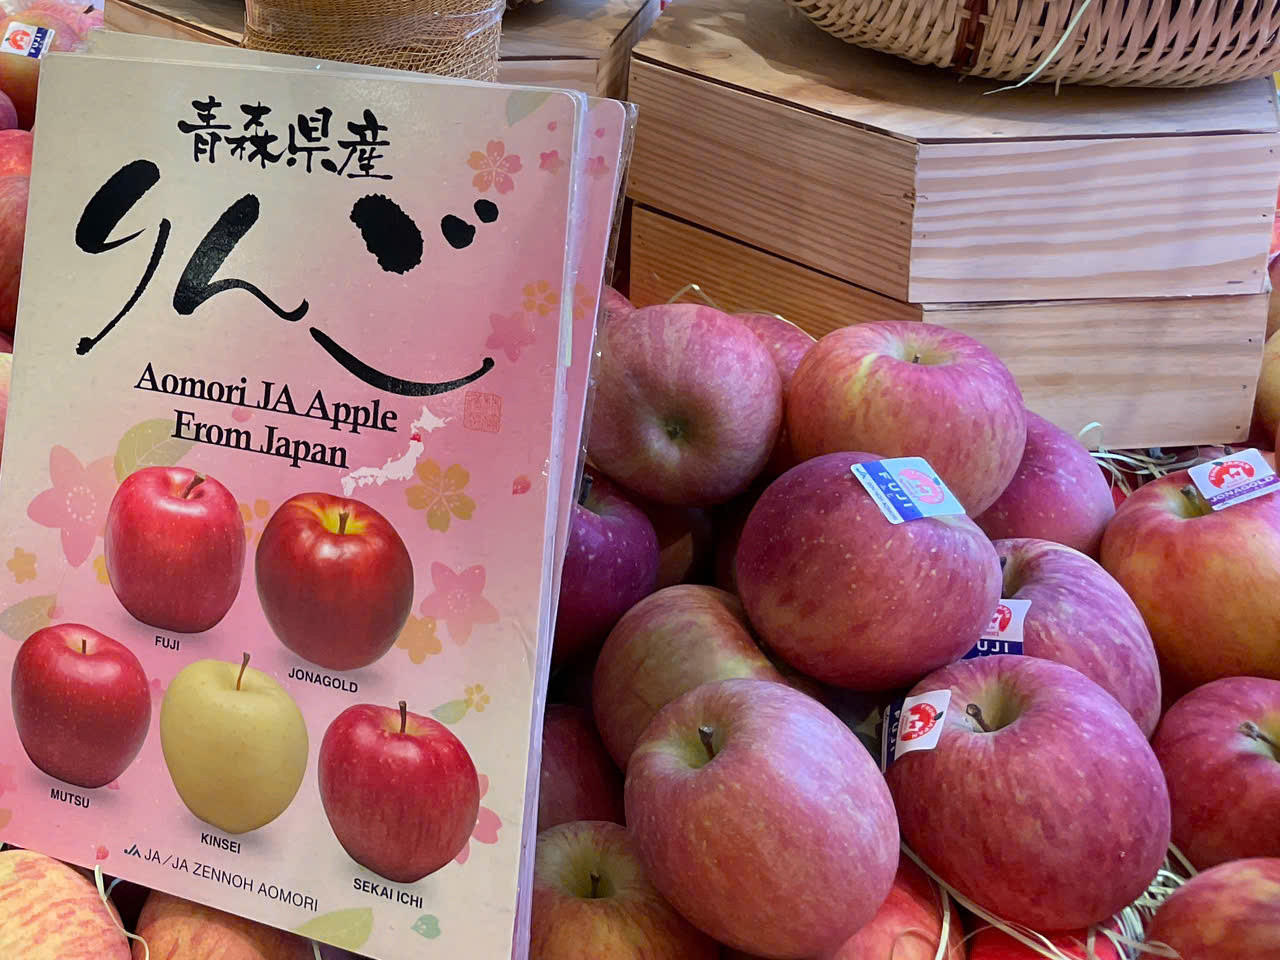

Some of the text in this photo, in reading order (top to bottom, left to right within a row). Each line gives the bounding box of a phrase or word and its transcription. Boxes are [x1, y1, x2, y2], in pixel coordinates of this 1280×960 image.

[177, 95, 393, 180] 青森県産
[134, 361, 398, 435] Aomori JA Apple
[171, 408, 350, 470] From Japan
[878, 471, 913, 508] FUJI
[1210, 475, 1275, 503] JONAGOLD
[154, 635, 180, 651] FUJI
[976, 640, 1009, 653] UJI
[288, 667, 359, 693] JONAGOLD
[50, 787, 91, 809] MUTSU
[200, 832, 241, 855] KINSEI
[192, 861, 255, 892] ZENNOH
[258, 881, 319, 913] AOMORI
[352, 877, 424, 910] SEKAI ICHI
